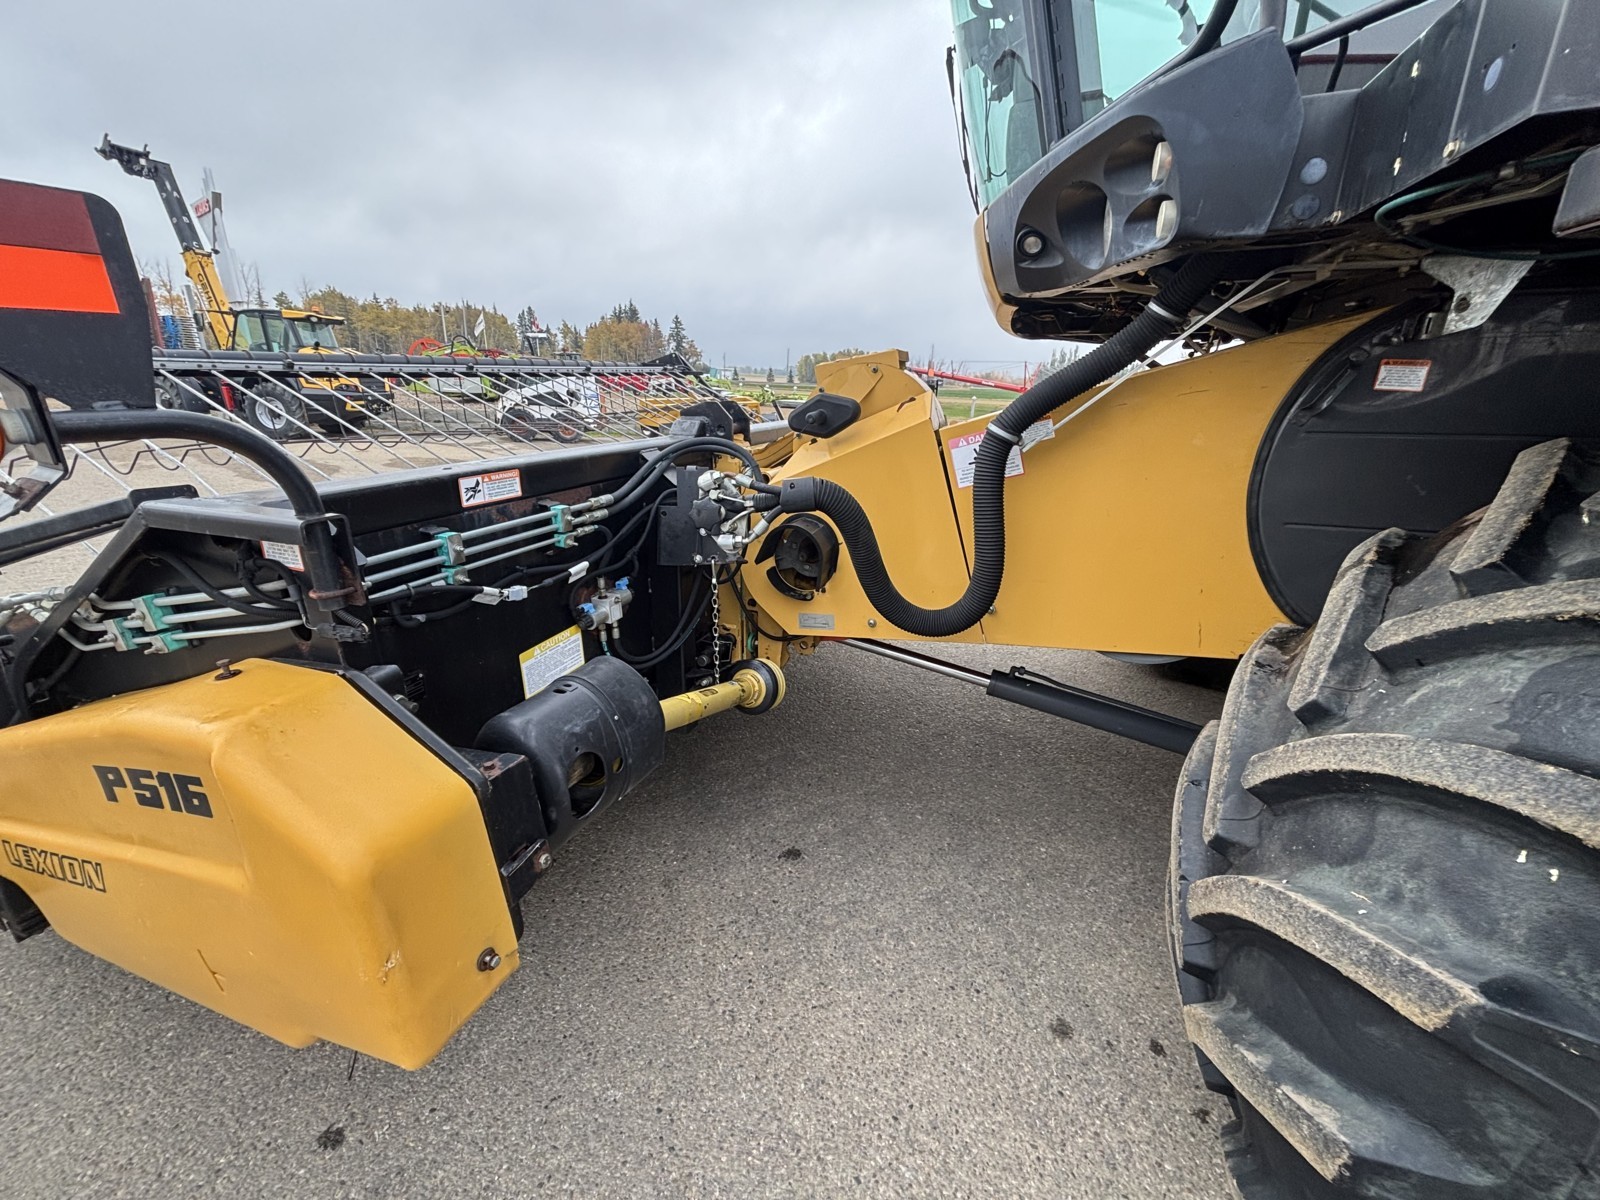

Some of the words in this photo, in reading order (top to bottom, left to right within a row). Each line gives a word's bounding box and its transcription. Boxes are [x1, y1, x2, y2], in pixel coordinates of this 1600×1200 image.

[197, 273, 213, 308] GEHL
[540, 629, 571, 651] CAUTION
[92, 765, 214, 818] P516
[1, 840, 107, 893] LEXION
